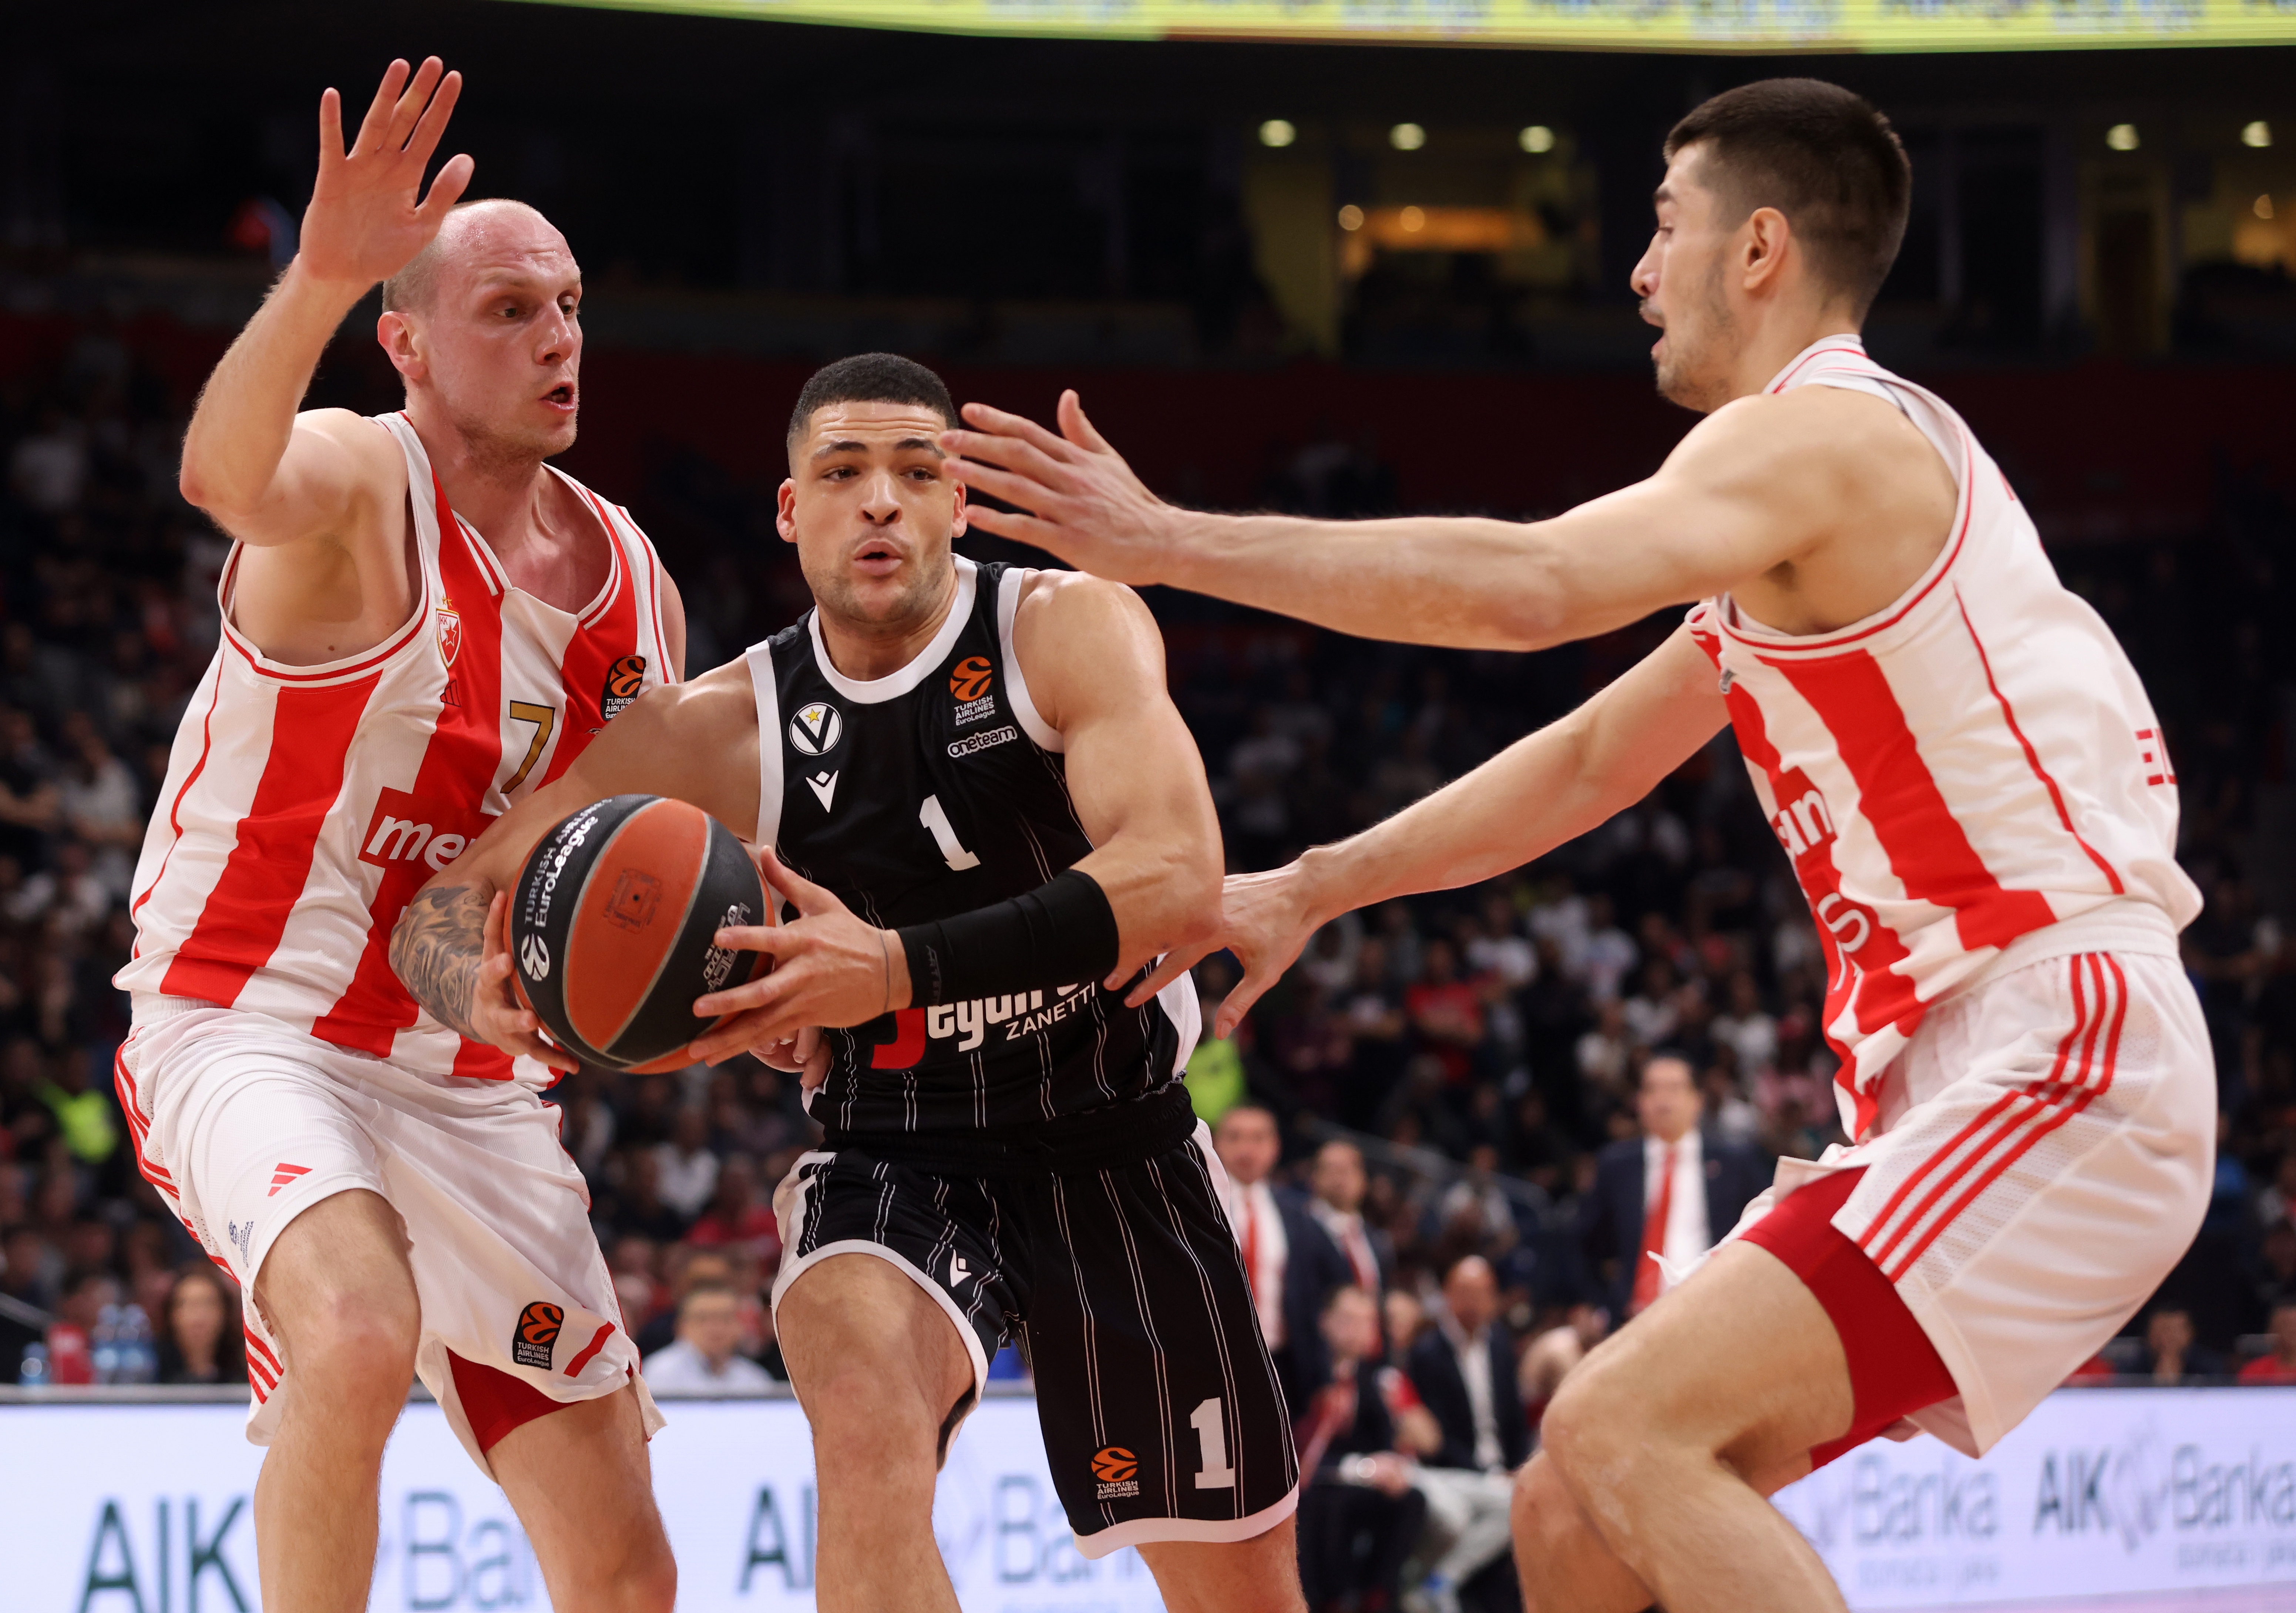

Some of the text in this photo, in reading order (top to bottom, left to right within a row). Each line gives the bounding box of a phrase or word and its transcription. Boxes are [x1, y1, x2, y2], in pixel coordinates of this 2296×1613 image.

[954, 695, 993, 713] TURKISH
[955, 701, 994, 720] AIRLINES
[955, 709, 995, 726] EuroLeague
[500, 700, 555, 794] 7
[949, 727, 1016, 756] oneteam
[919, 794, 981, 871] 1
[525, 847, 556, 924] TURKISH
[535, 816, 598, 927] EuroLeague
[1005, 981, 1095, 1041] ZANETTI
[517, 1342, 549, 1353] TURKISH
[517, 1349, 549, 1361] AIRLINES
[518, 1356, 549, 1367] EuroLeague
[1190, 1397, 1234, 1489] 1
[1096, 1481, 1138, 1489] TURKISH
[1097, 1485, 1139, 1495] AIRLINES
[1097, 1491, 1140, 1500] EuroLeague
[1853, 1454, 1999, 1543] Banka
[2033, 1448, 2111, 1532] AIK
[76, 1498, 252, 1613] AIK
